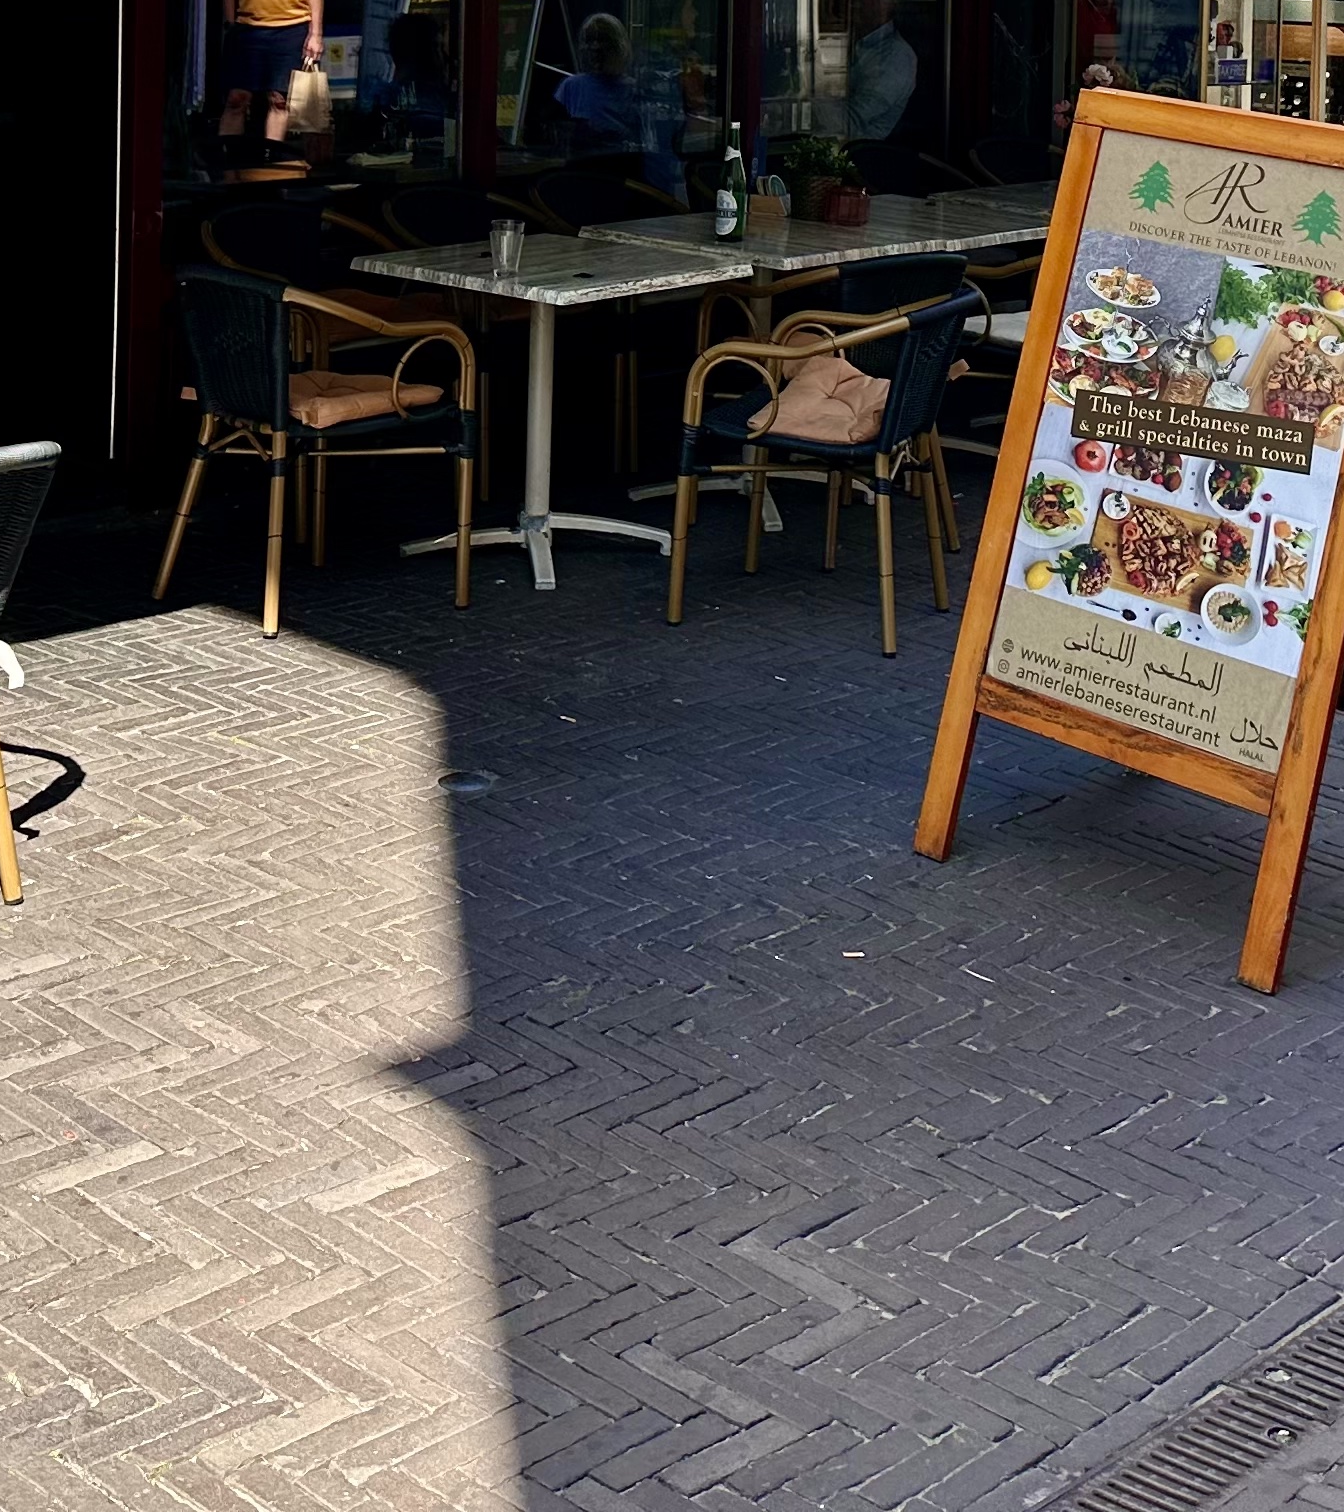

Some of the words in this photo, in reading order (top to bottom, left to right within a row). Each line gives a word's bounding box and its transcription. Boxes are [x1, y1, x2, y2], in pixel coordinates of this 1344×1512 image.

[1129, 221, 1185, 242] DISCOVER
[1189, 233, 1211, 247] THE
[1217, 239, 1252, 255] TASTE
[1255, 246, 1270, 259] OF
[1274, 250, 1337, 272] LEBANON!
[1222, 213, 1283, 238] AMIER
[1079, 419, 1091, 431] &
[1096, 419, 1133, 438] grill
[1138, 427, 1229, 454] specialties
[1236, 439, 1254, 458] in
[1261, 447, 1307, 466] town
[1089, 395, 1122, 415] The
[1128, 402, 1163, 422] best
[1169, 407, 1250, 435] Lebanese
[1257, 427, 1303, 444] maza
[1020, 645, 1217, 724] www.amierrestaurant.nl
[1143, 651, 1224, 697] المطعم
[1016, 664, 1221, 748] amierlebaneserestaurant
[1229, 717, 1279, 752] حلال
[1239, 748, 1265, 763] HALAL
